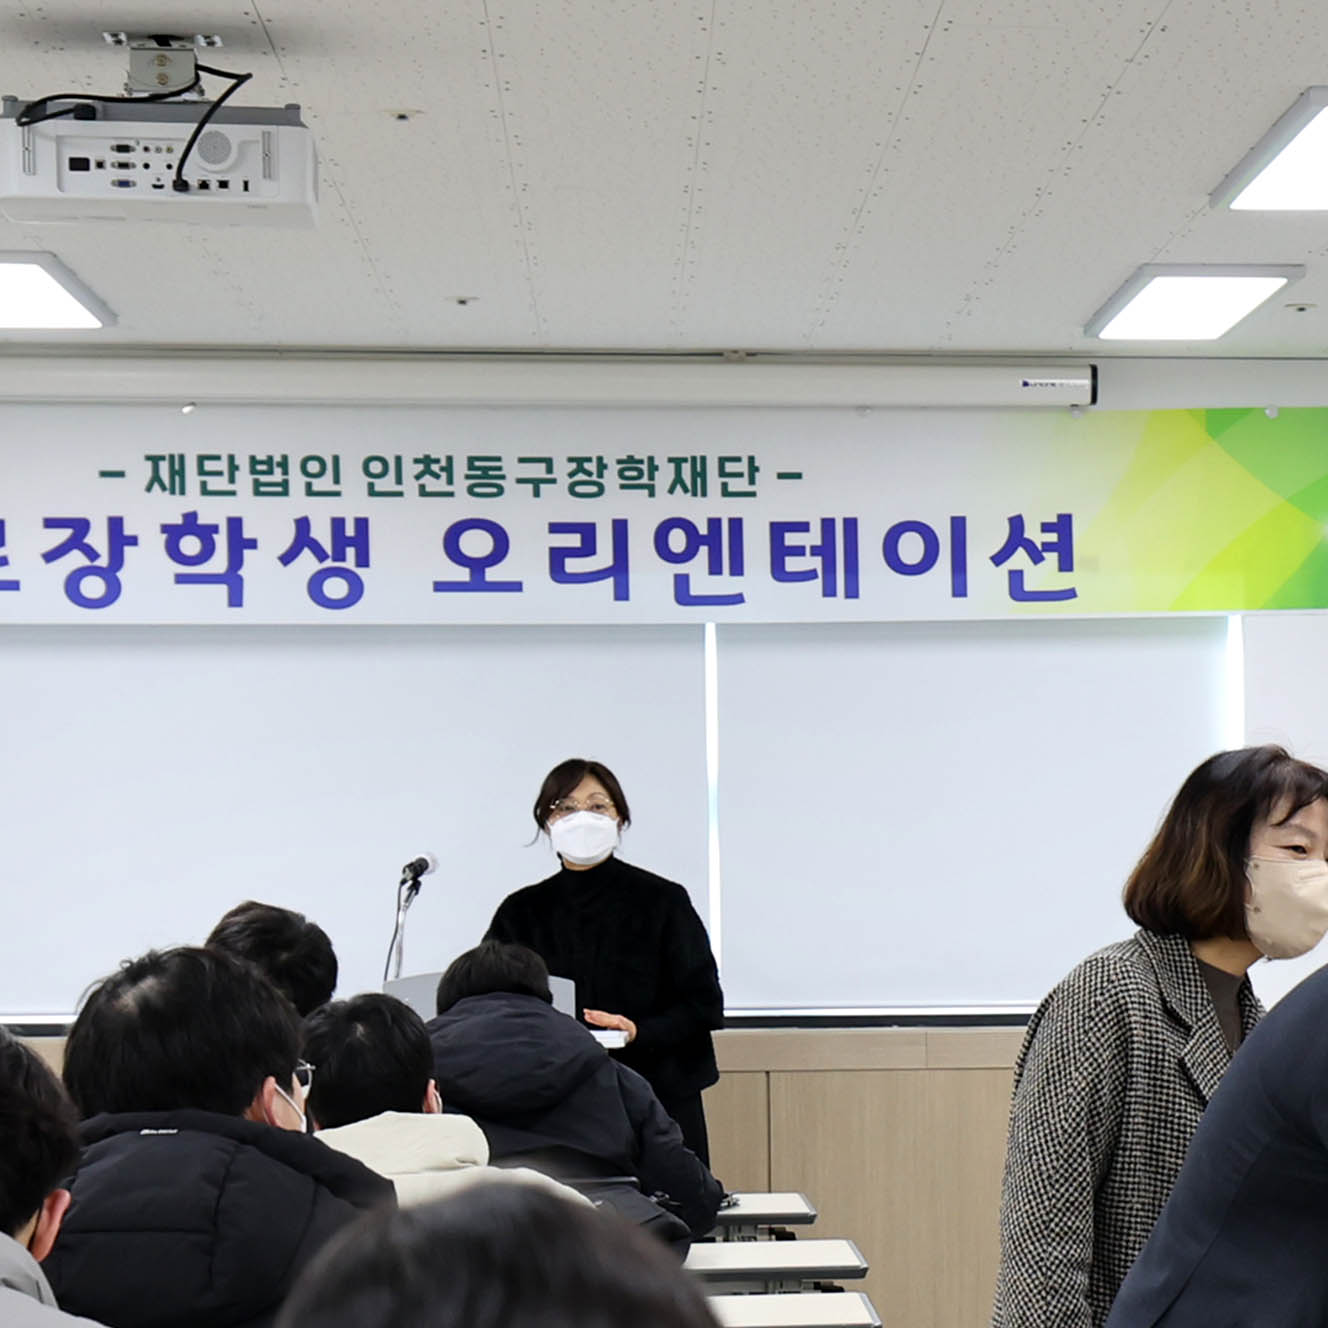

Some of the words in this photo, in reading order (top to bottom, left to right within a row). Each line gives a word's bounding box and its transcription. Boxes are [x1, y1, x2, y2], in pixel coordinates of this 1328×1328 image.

[143, 452, 342, 498] 재단법인
[361, 453, 761, 499] 인천동구장학재단
[432, 512, 1078, 607] 오리엔테이션
